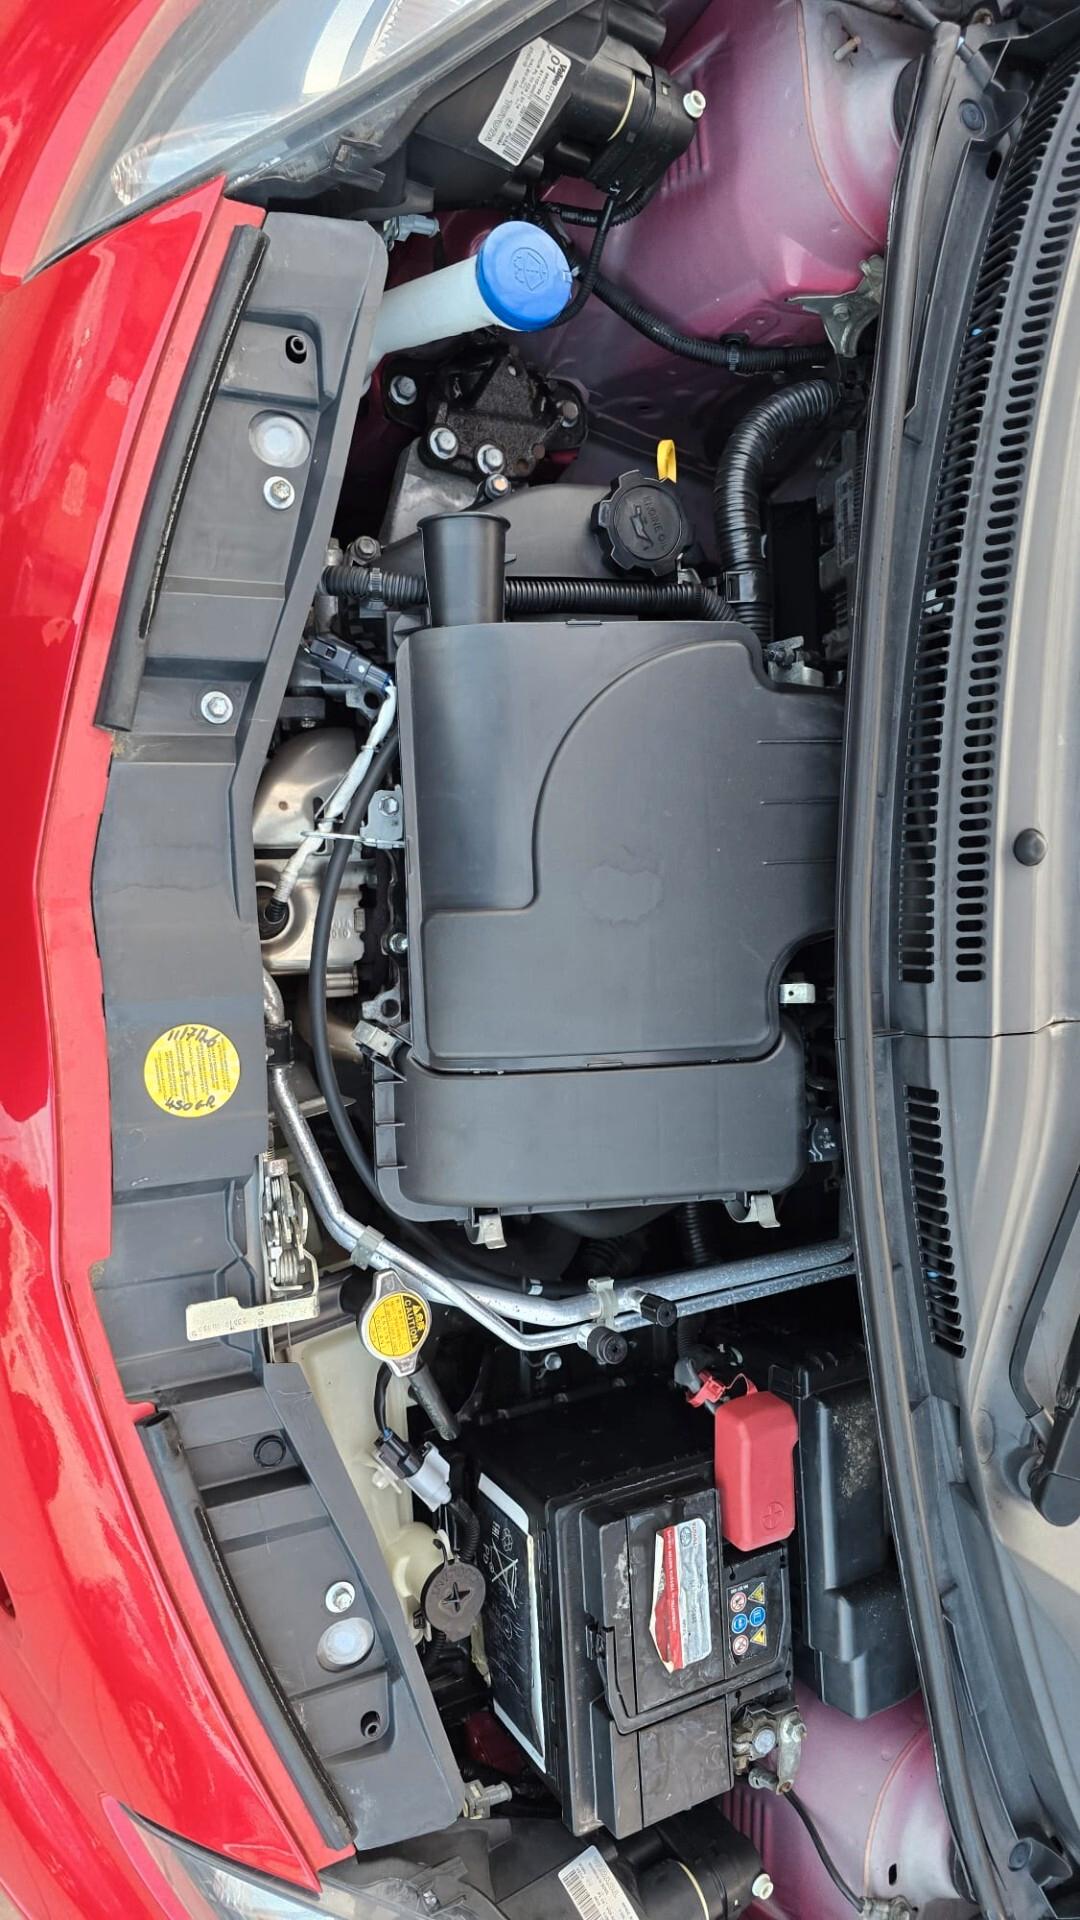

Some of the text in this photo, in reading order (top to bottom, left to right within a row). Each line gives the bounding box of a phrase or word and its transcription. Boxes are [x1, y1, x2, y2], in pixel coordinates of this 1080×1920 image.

[547, 55, 560, 73] 01
[553, 62, 568, 87] Valeo
[404, 1299, 419, 1343] CAUTION
